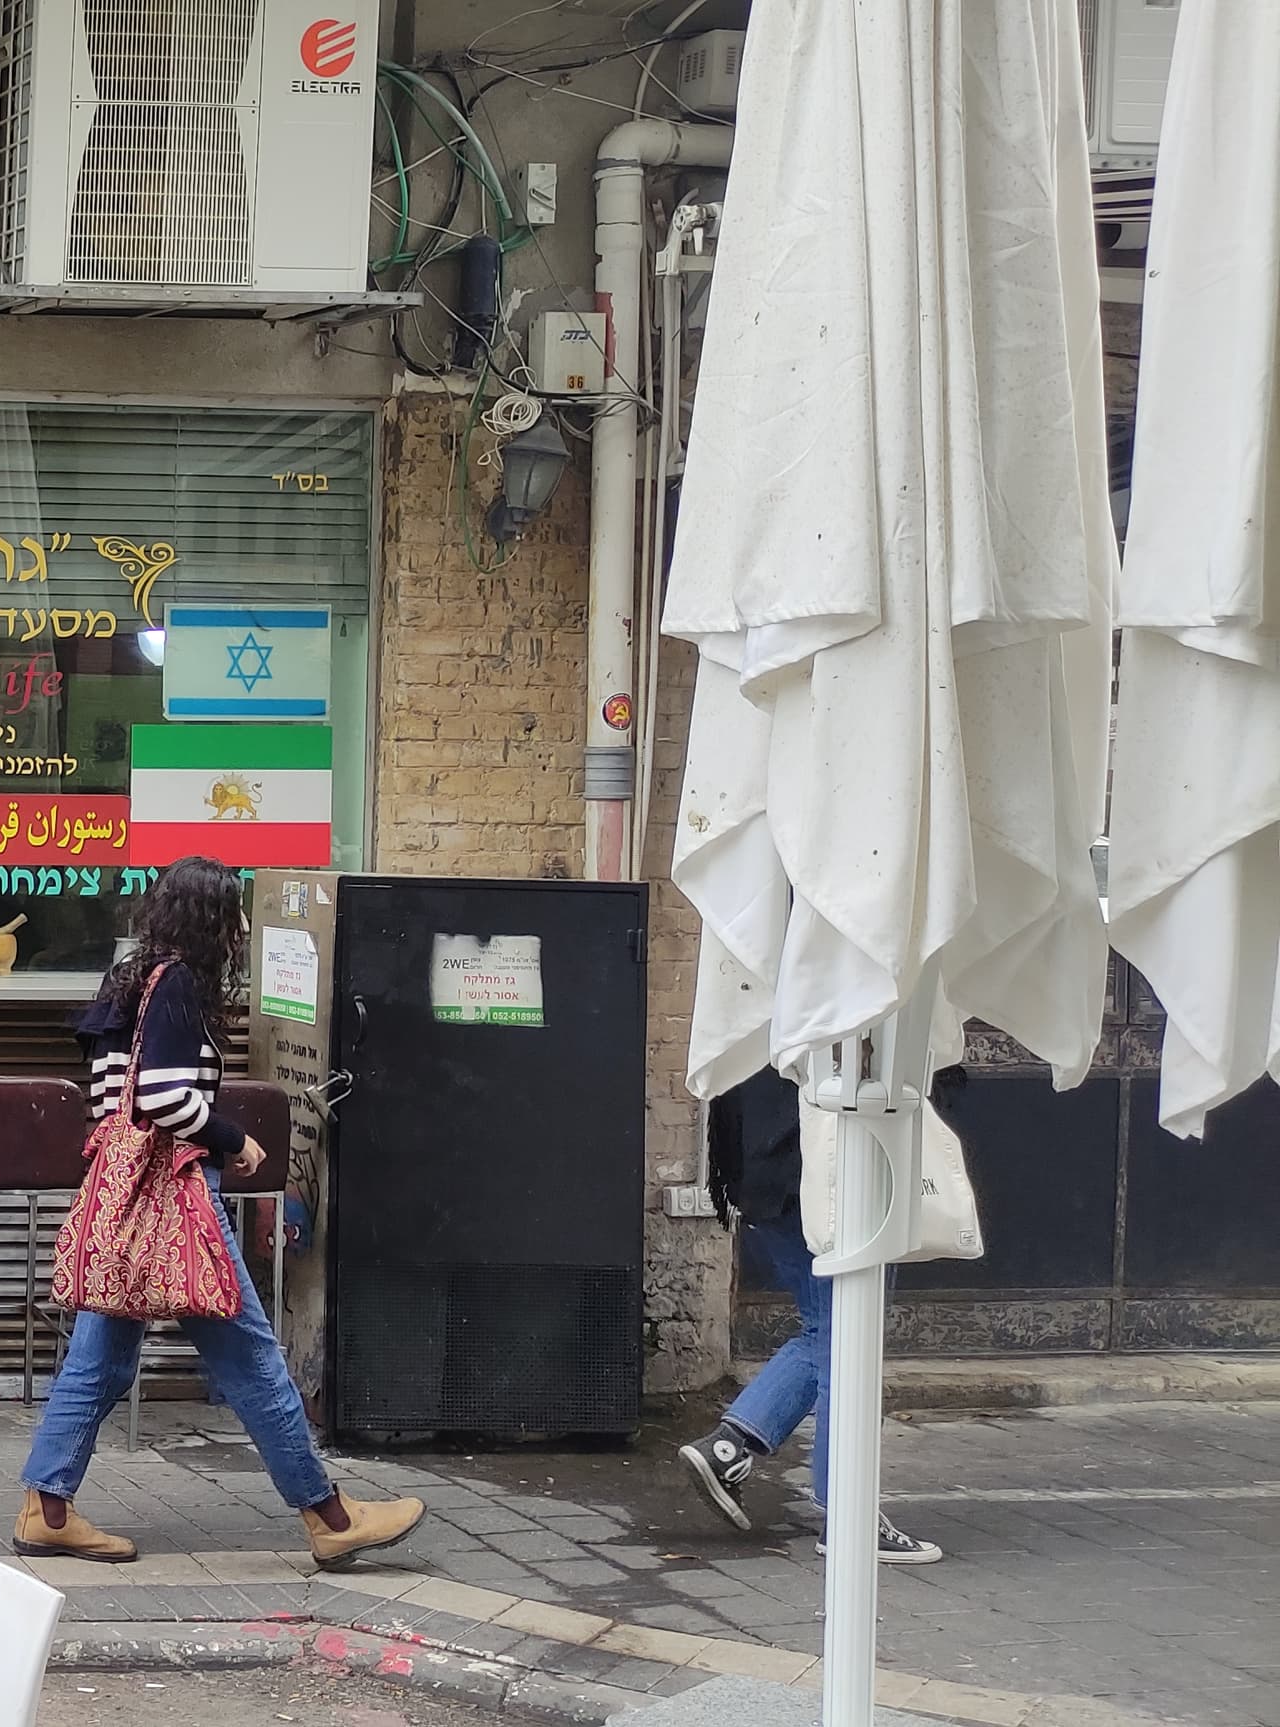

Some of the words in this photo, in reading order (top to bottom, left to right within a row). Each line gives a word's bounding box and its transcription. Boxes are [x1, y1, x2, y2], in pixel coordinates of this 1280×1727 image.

[290, 80, 361, 94] ELECTRA
[568, 375, 584, 389] 36
[272, 471, 328, 491] בס"ד
[27, 804, 127, 854] رستوران
[443, 959, 469, 969] 2WE
[464, 974, 501, 986] מתלקח
[505, 976, 516, 984] גז
[494, 991, 519, 1000] אסור
